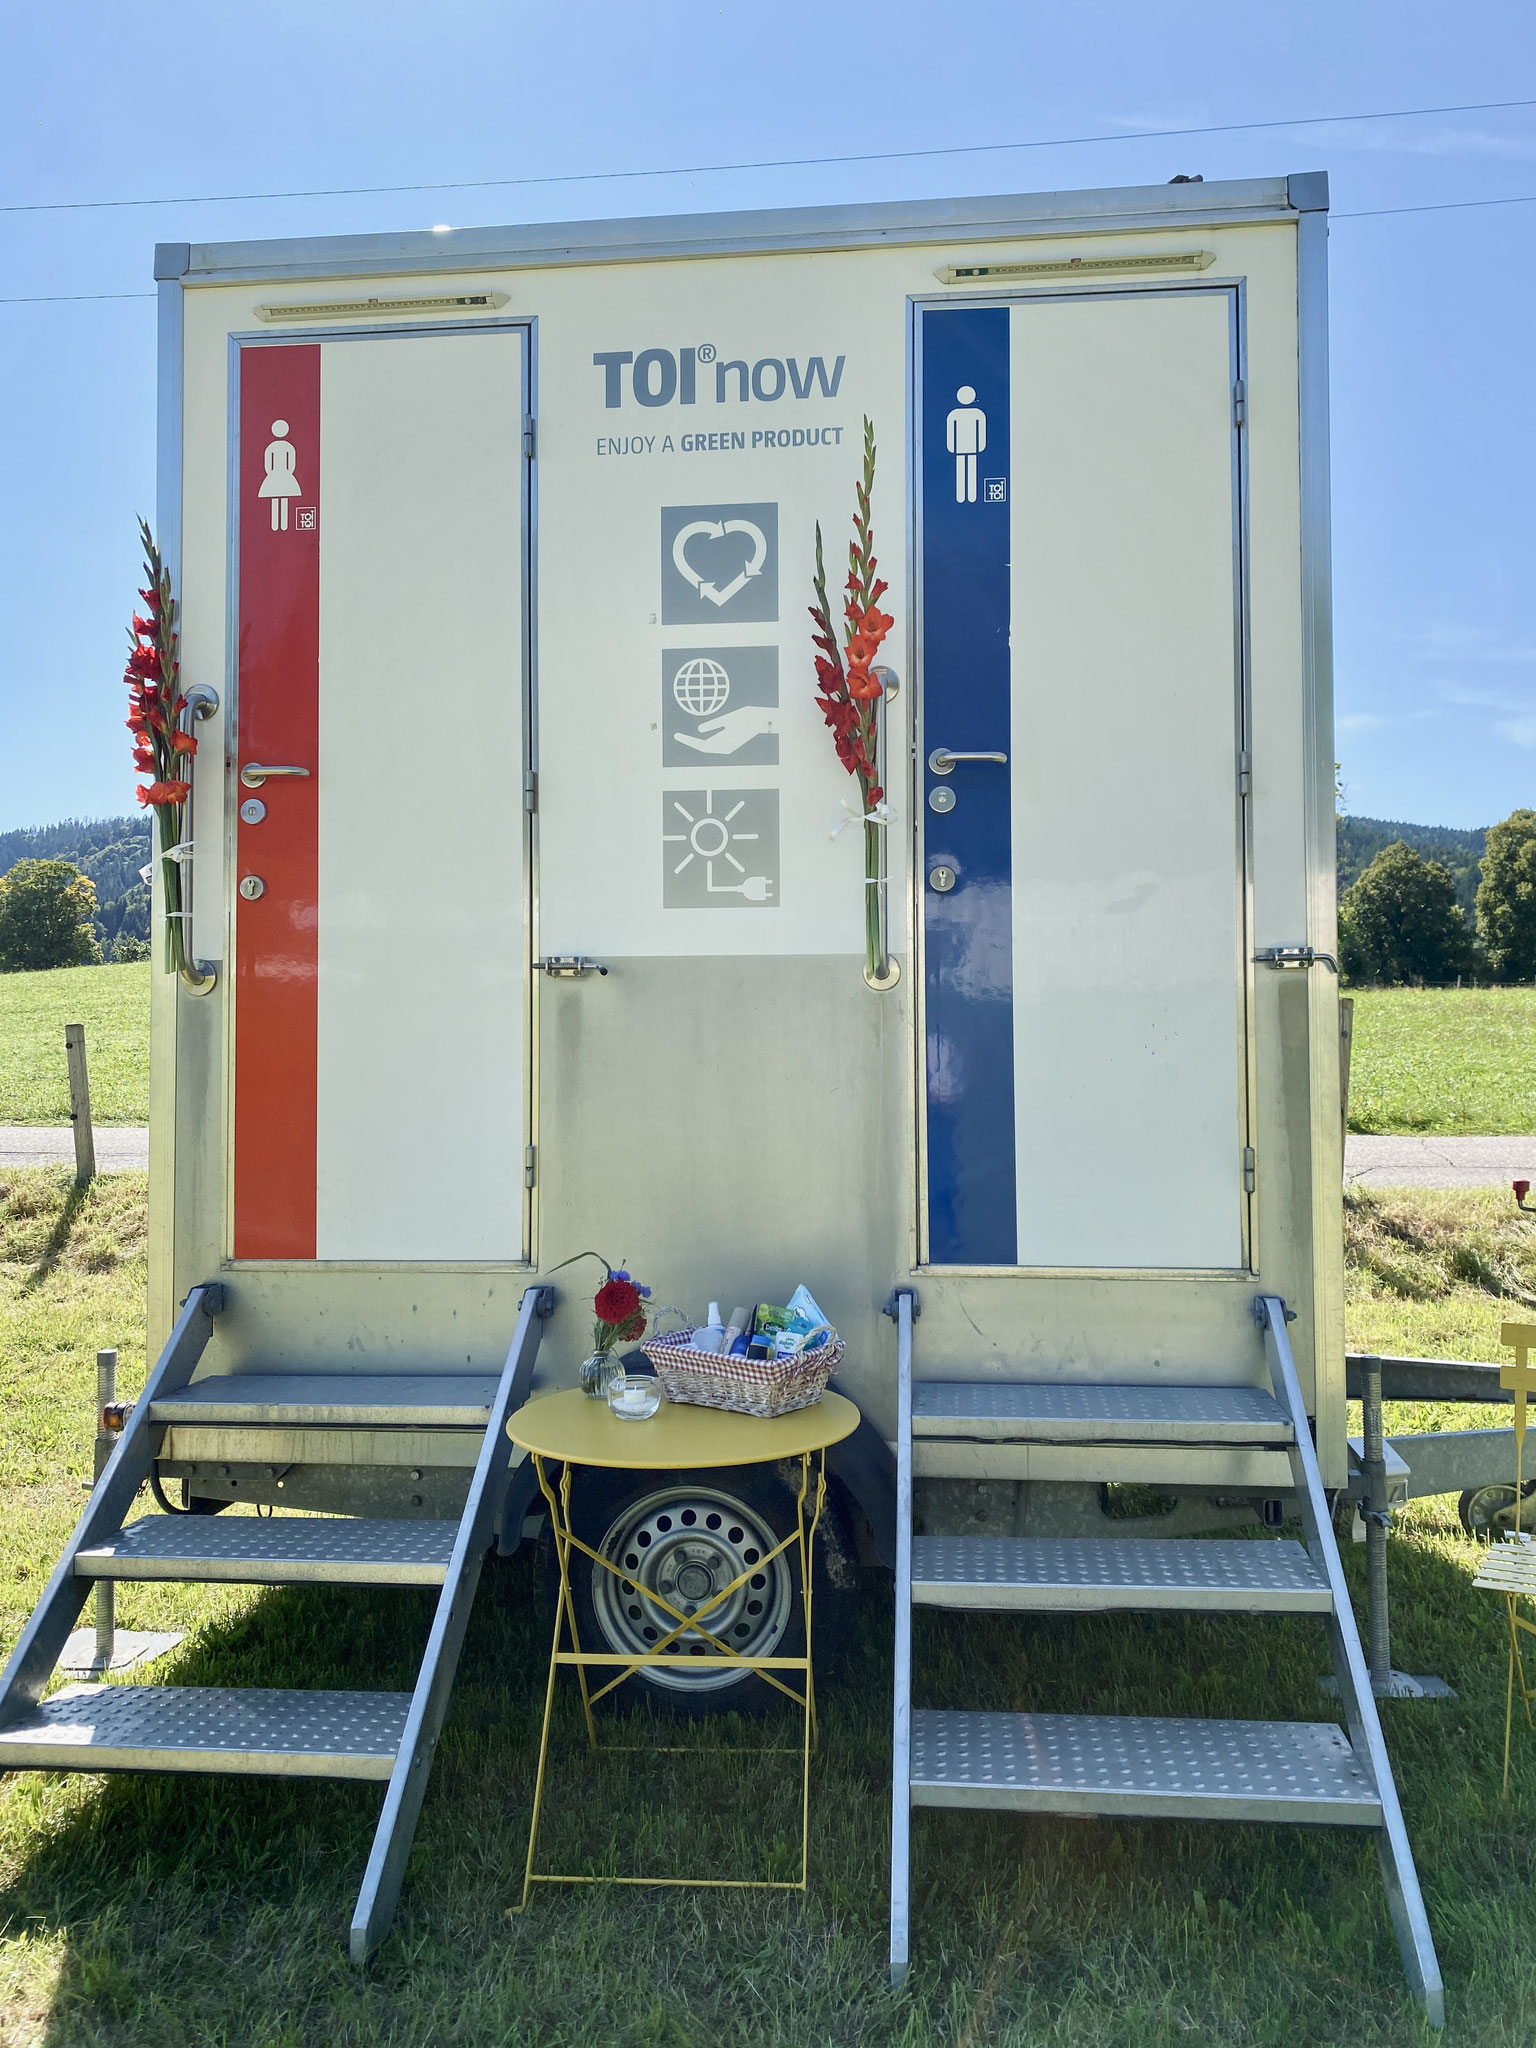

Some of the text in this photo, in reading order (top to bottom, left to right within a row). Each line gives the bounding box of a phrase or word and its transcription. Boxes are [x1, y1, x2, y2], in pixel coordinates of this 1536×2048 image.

[597, 427, 844, 455] ENJOY A GREEN PRODUCT
